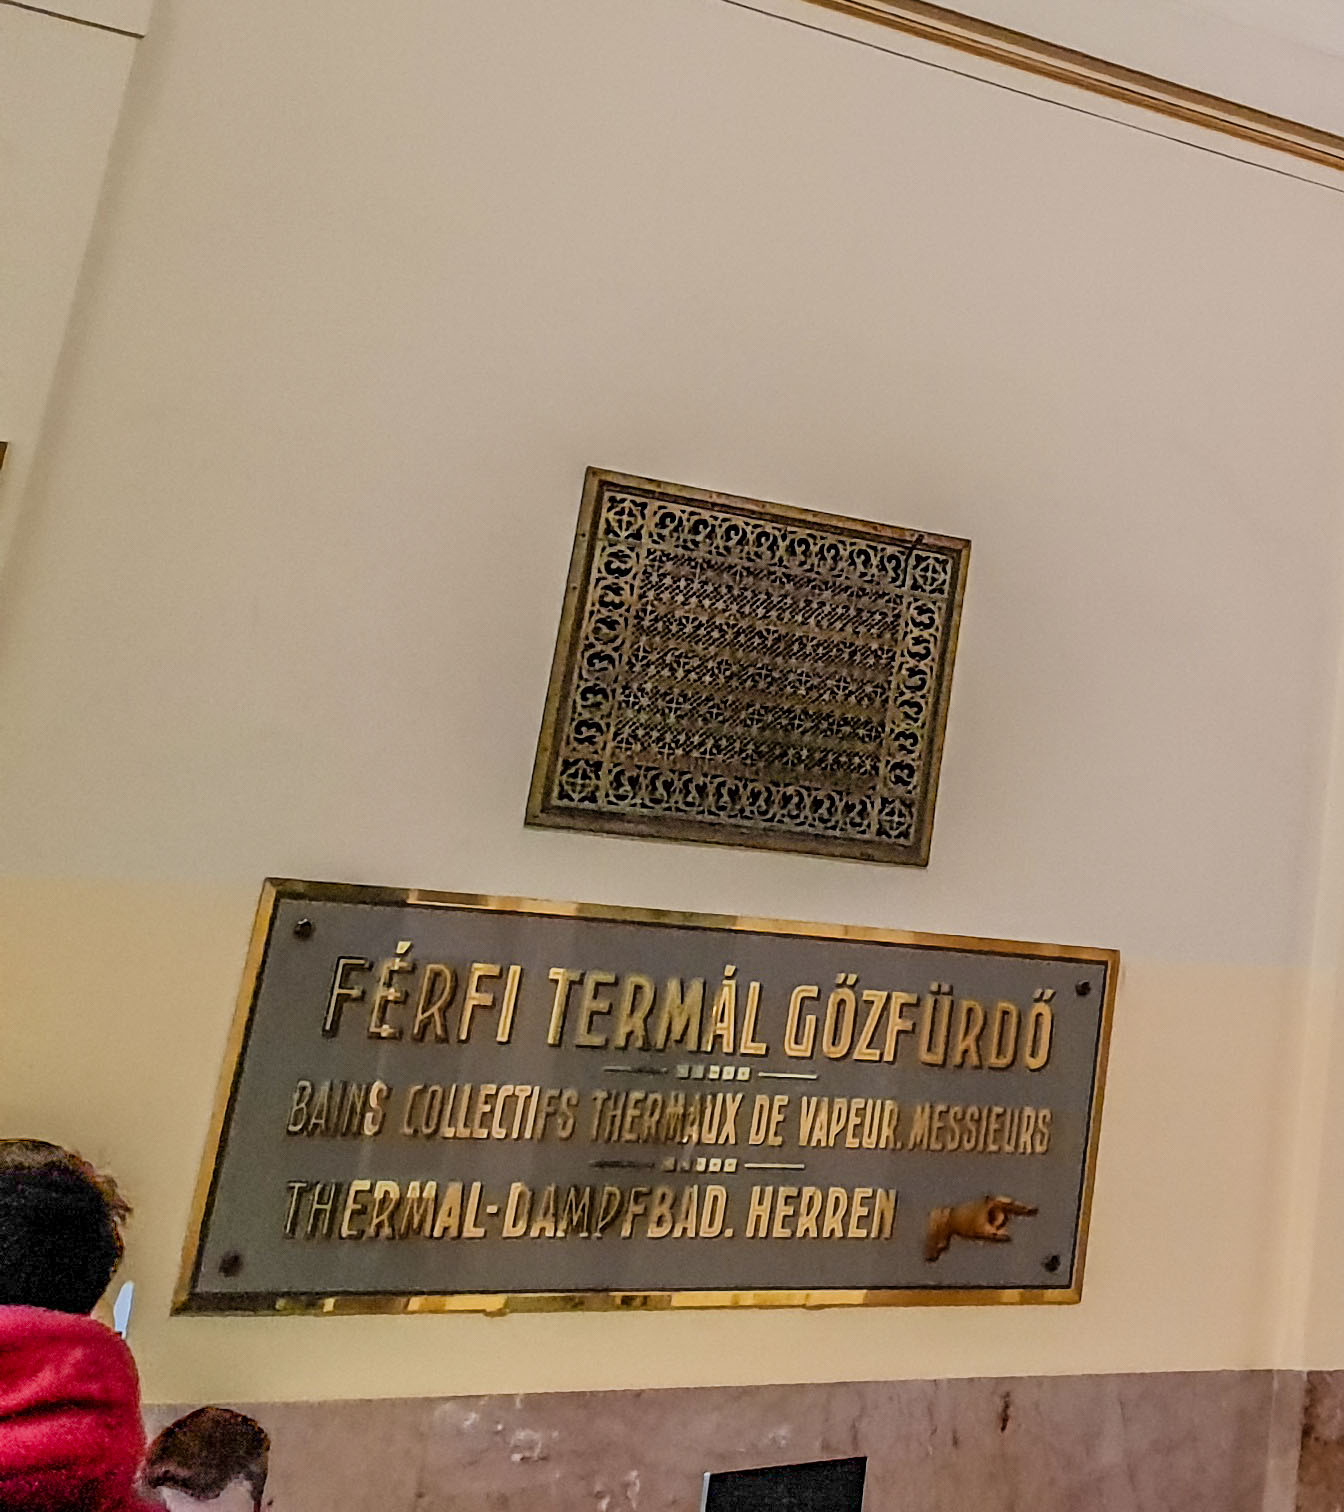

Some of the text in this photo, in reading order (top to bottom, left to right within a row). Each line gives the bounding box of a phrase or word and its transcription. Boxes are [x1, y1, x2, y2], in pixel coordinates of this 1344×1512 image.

[322, 941, 1056, 1071] FÉRFI TERMÁL GŐZFÜRDŐ
[286, 1080, 390, 1139] BAINS
[401, 1083, 578, 1140] COLLECTIFS
[589, 1089, 743, 1145] THERMAUX
[748, 1094, 789, 1146] DE
[908, 1100, 1053, 1154] MESSIEURS
[745, 1185, 898, 1240] HERREN
